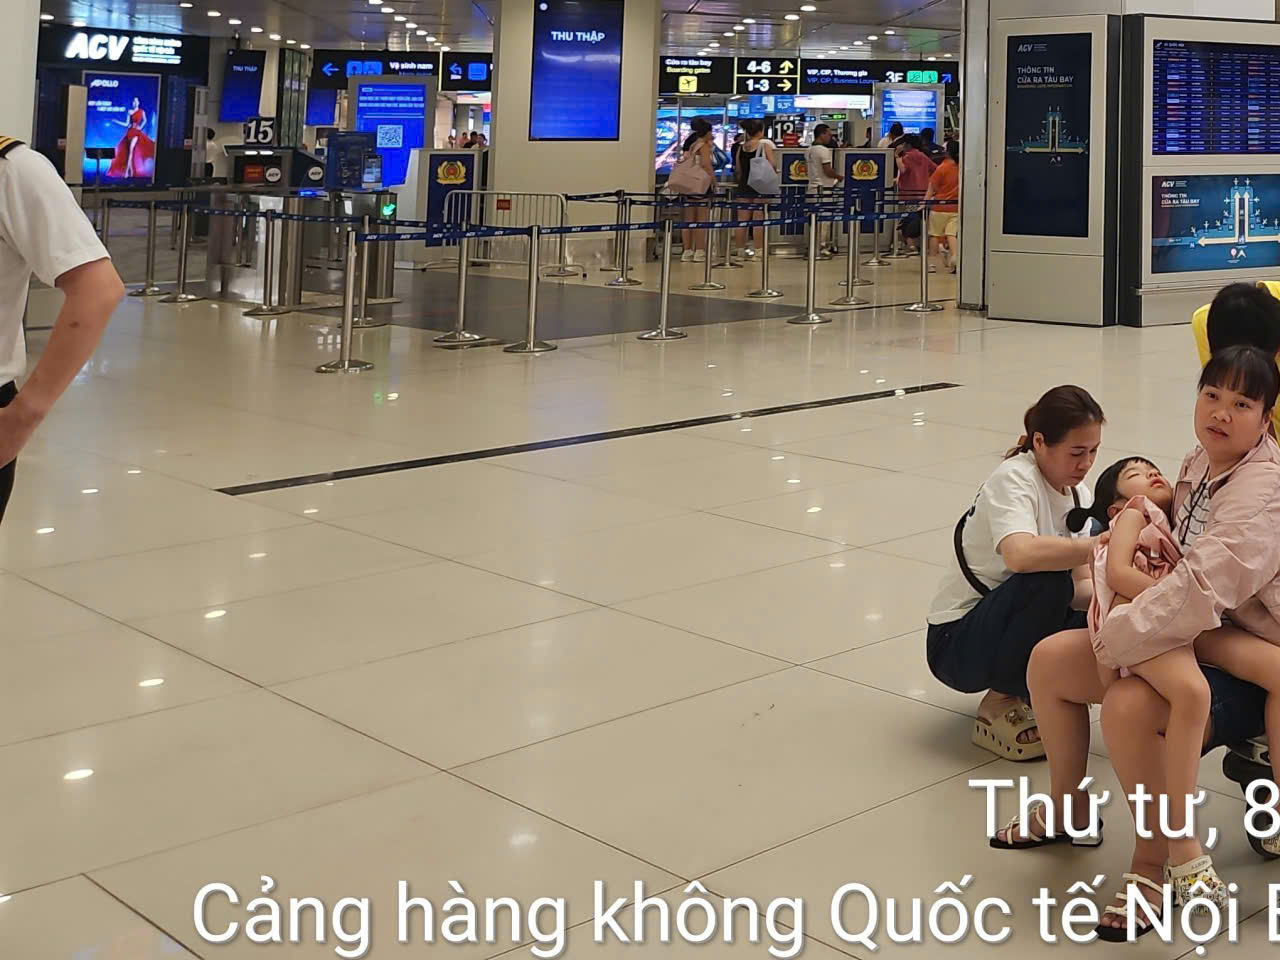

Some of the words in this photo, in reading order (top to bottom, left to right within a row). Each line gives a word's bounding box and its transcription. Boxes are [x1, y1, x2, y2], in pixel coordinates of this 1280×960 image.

[551, 31, 574, 43] THU
[575, 30, 605, 44] THẬP
[64, 32, 130, 61] ACV
[1017, 44, 1033, 52] ACV
[746, 60, 772, 74] 4-6
[1017, 65, 1041, 74] THÔNG
[1042, 66, 1055, 74] TIN
[745, 78, 770, 92] 1-3
[1044, 75, 1058, 83] TÀU
[245, 119, 274, 144] 15
